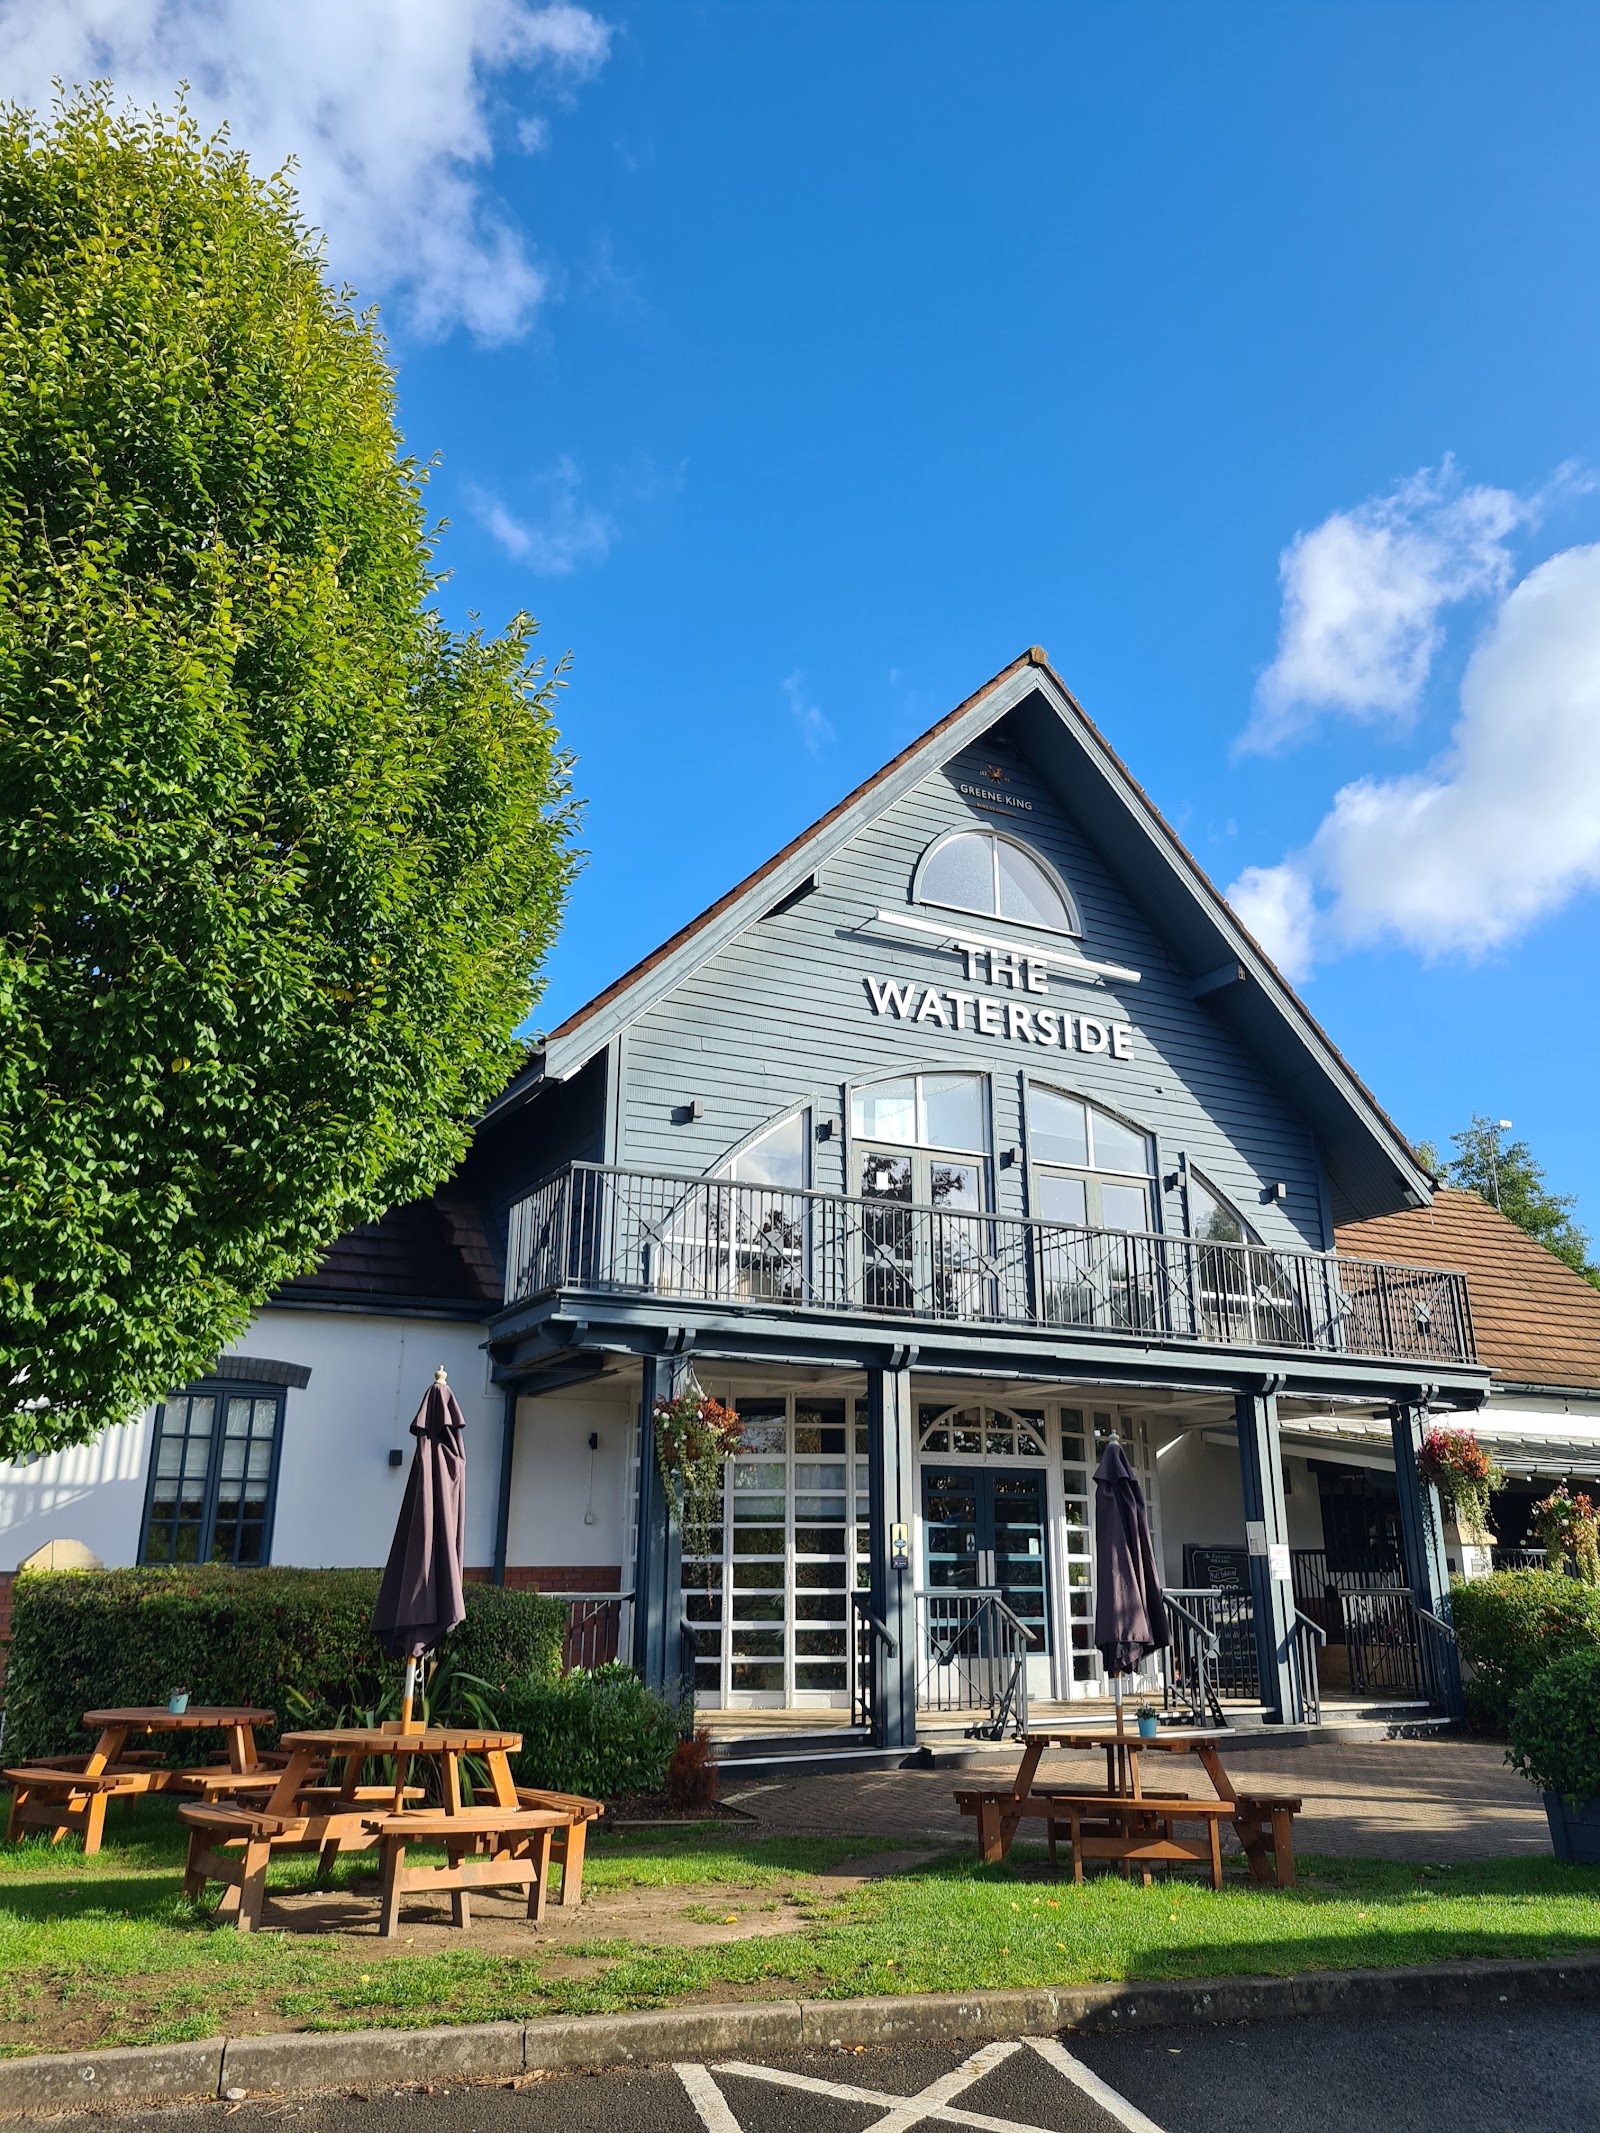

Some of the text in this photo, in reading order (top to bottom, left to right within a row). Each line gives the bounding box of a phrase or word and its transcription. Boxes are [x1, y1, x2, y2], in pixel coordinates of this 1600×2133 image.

[960, 784, 1033, 811] GREENE KING
[959, 941, 1049, 994] THE
[867, 975, 1135, 1061] WATERSIDE
